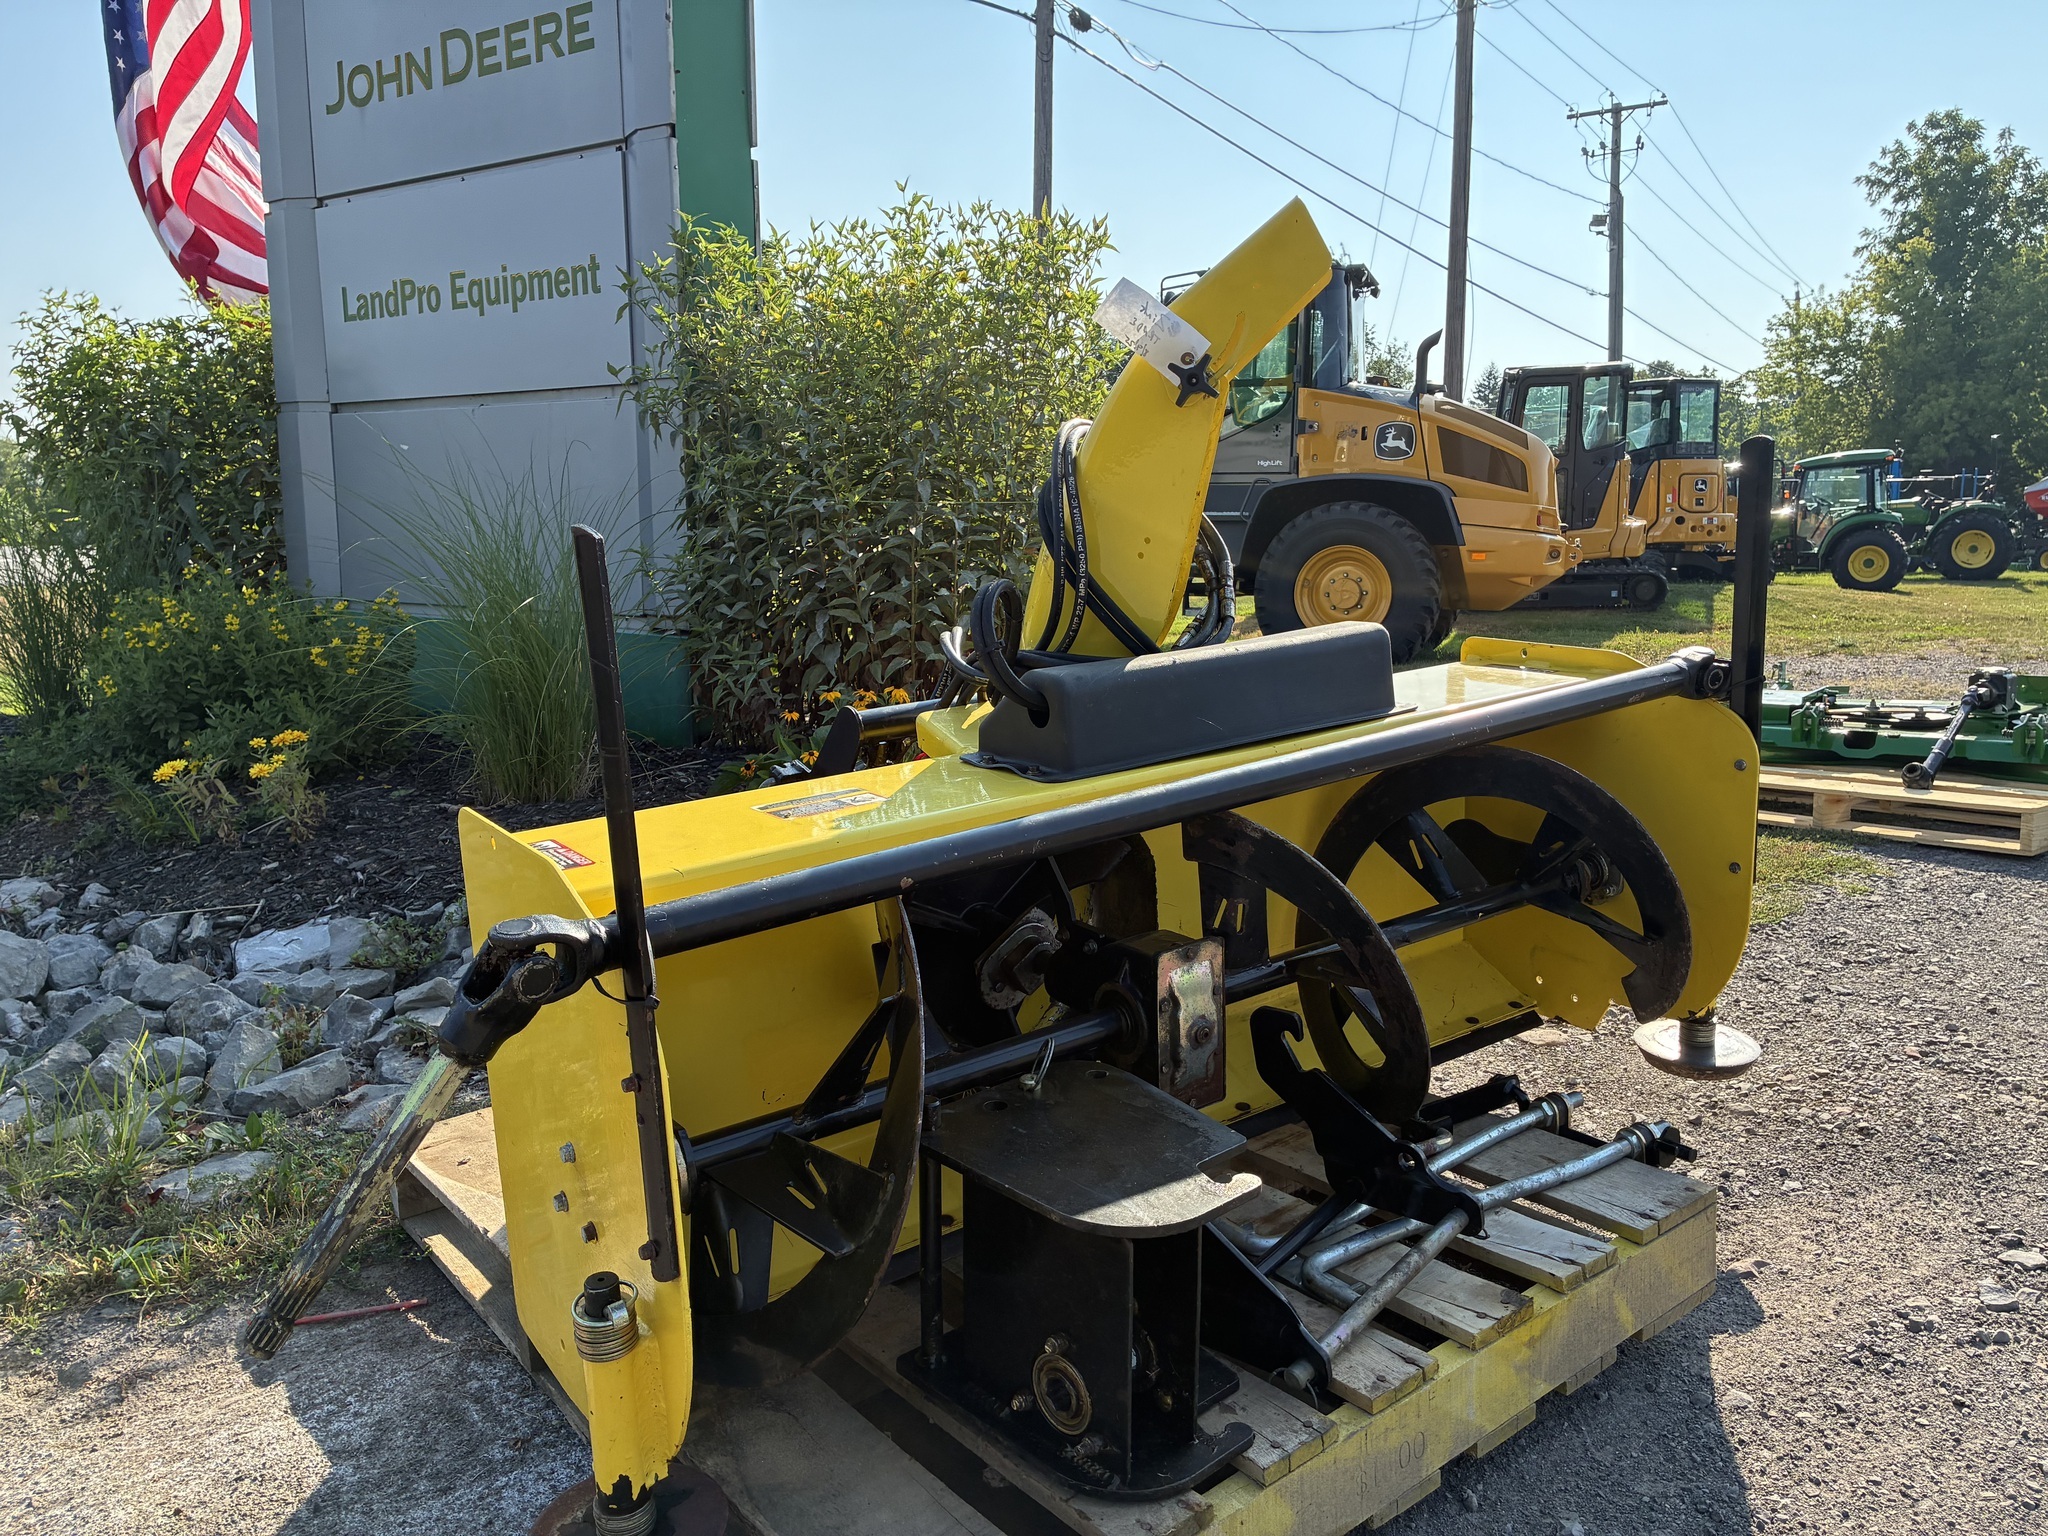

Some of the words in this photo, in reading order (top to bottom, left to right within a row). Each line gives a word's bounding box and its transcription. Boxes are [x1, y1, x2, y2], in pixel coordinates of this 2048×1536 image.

[325, 46, 433, 115] JOHN
[439, 1, 595, 86] DEERE
[341, 278, 440, 323] LandPro
[450, 254, 601, 317] Equipment
